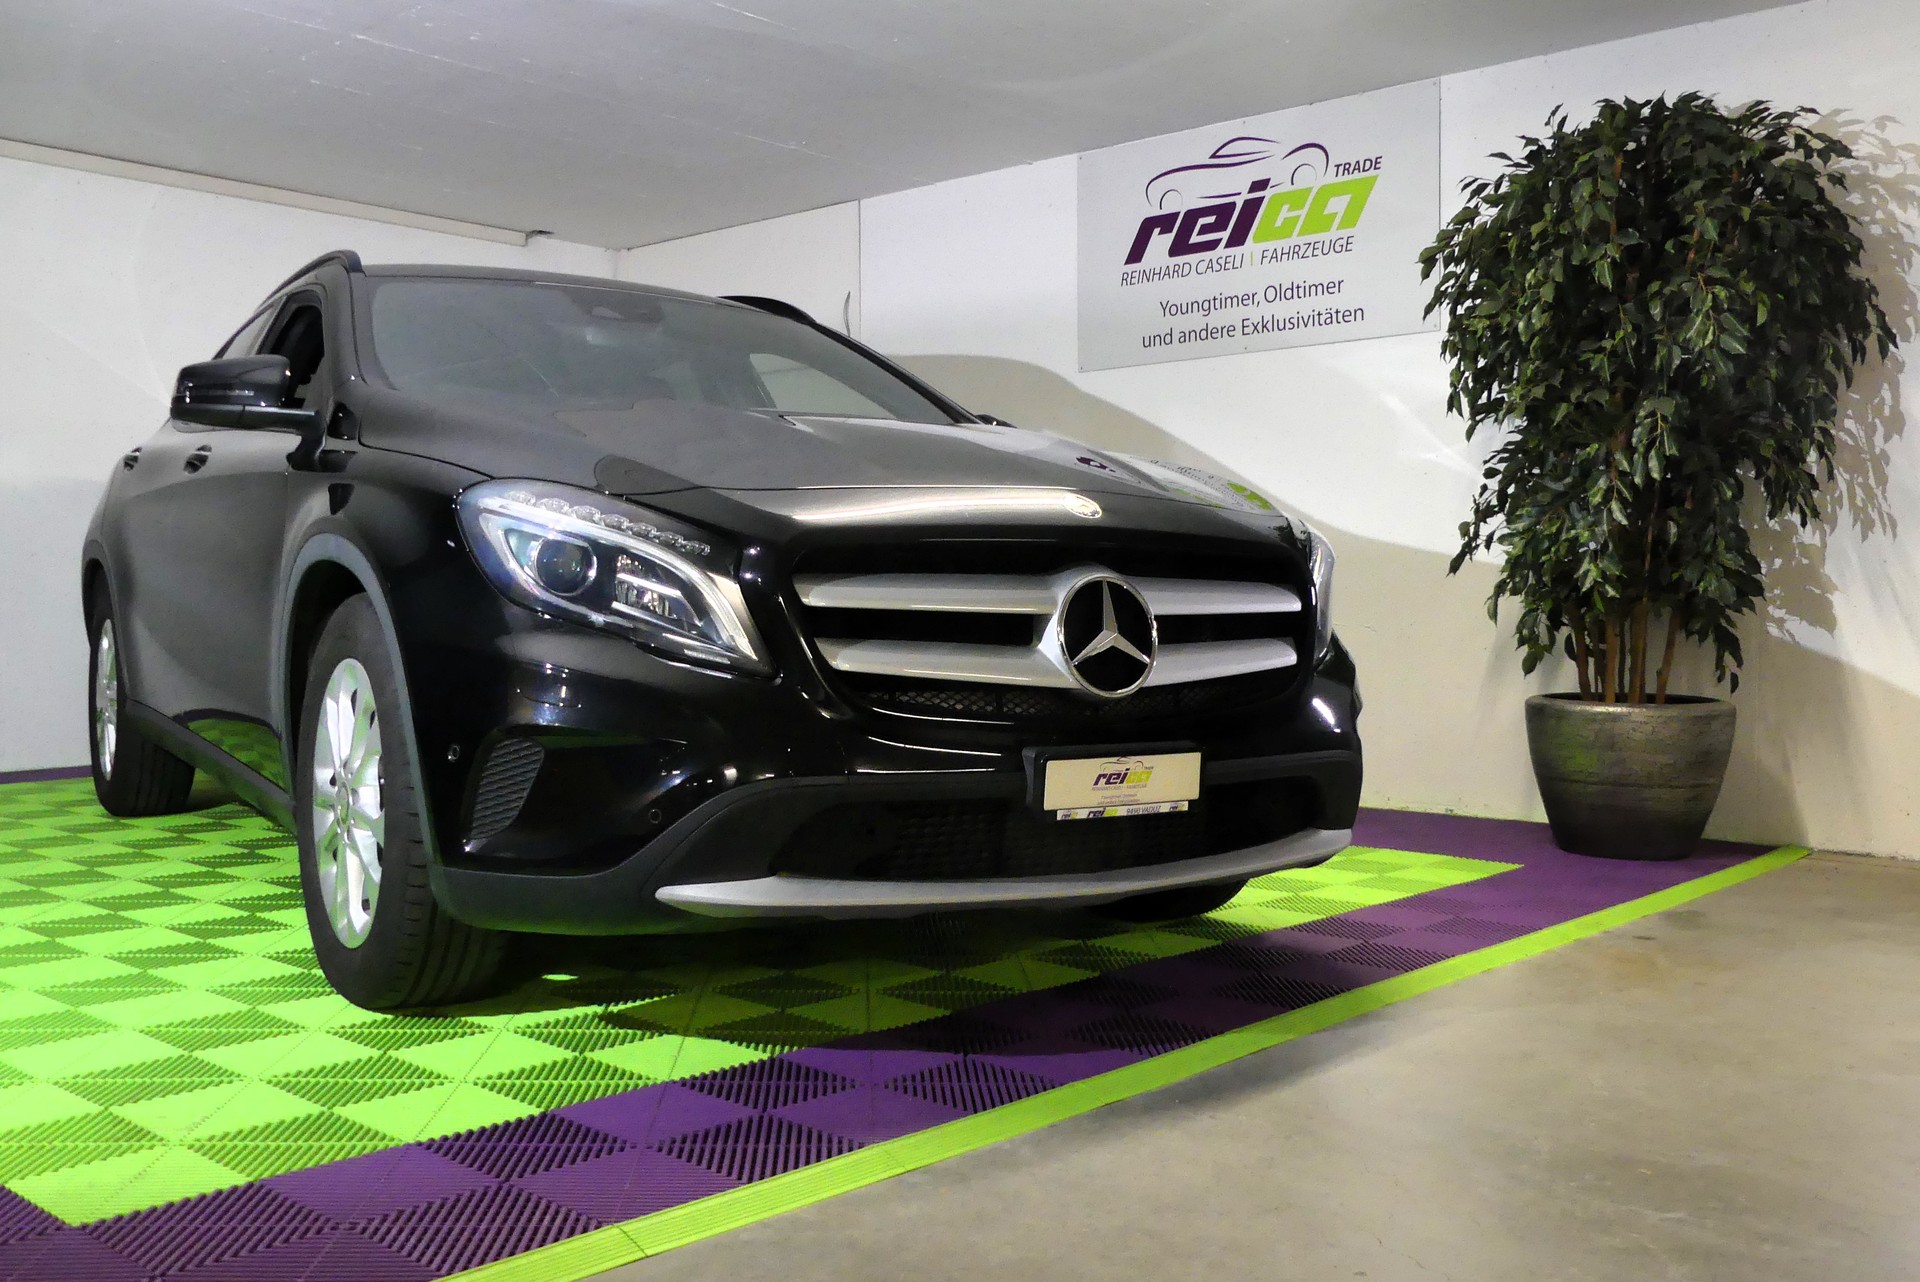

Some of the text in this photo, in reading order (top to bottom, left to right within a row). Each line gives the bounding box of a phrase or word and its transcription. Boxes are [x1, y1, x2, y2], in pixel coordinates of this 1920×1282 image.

[1333, 156, 1383, 178] TRADE
[1124, 175, 1380, 266] reica
[1120, 235, 1355, 287] REINHARD CASELI FAHRZEUGE
[1159, 279, 1344, 318] Youngtimer, Oldtimer
[1142, 306, 1365, 349] und andere Exklusivitäten
